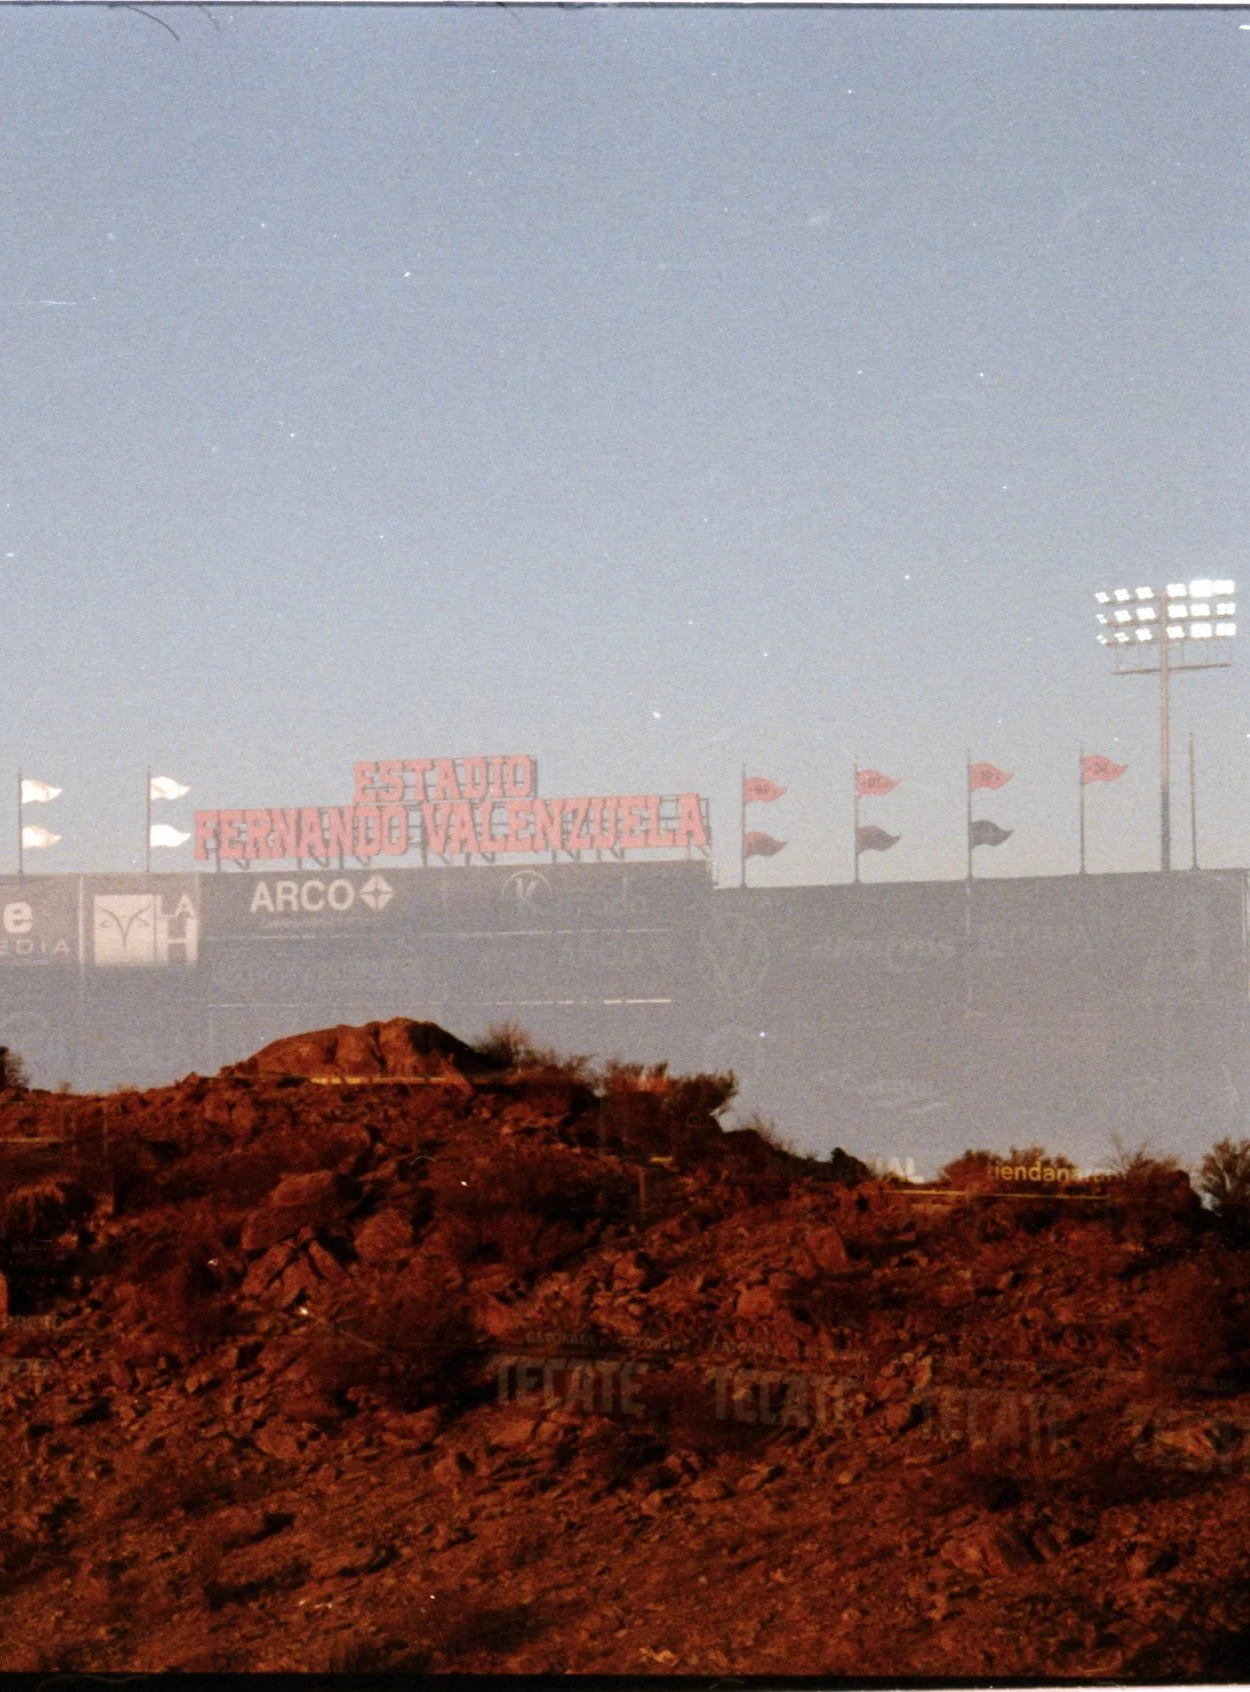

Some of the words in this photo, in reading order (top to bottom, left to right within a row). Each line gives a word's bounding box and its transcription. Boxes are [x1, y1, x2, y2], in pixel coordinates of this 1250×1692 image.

[353, 755, 536, 801] ESTADIO
[194, 804, 408, 860] FERNANDO
[422, 792, 707, 856] VALENZUELA
[2, 901, 33, 934] e
[250, 879, 355, 913] ARCO
[486, 1353, 650, 1416] TECATE
[701, 1363, 858, 1428] TECATE
